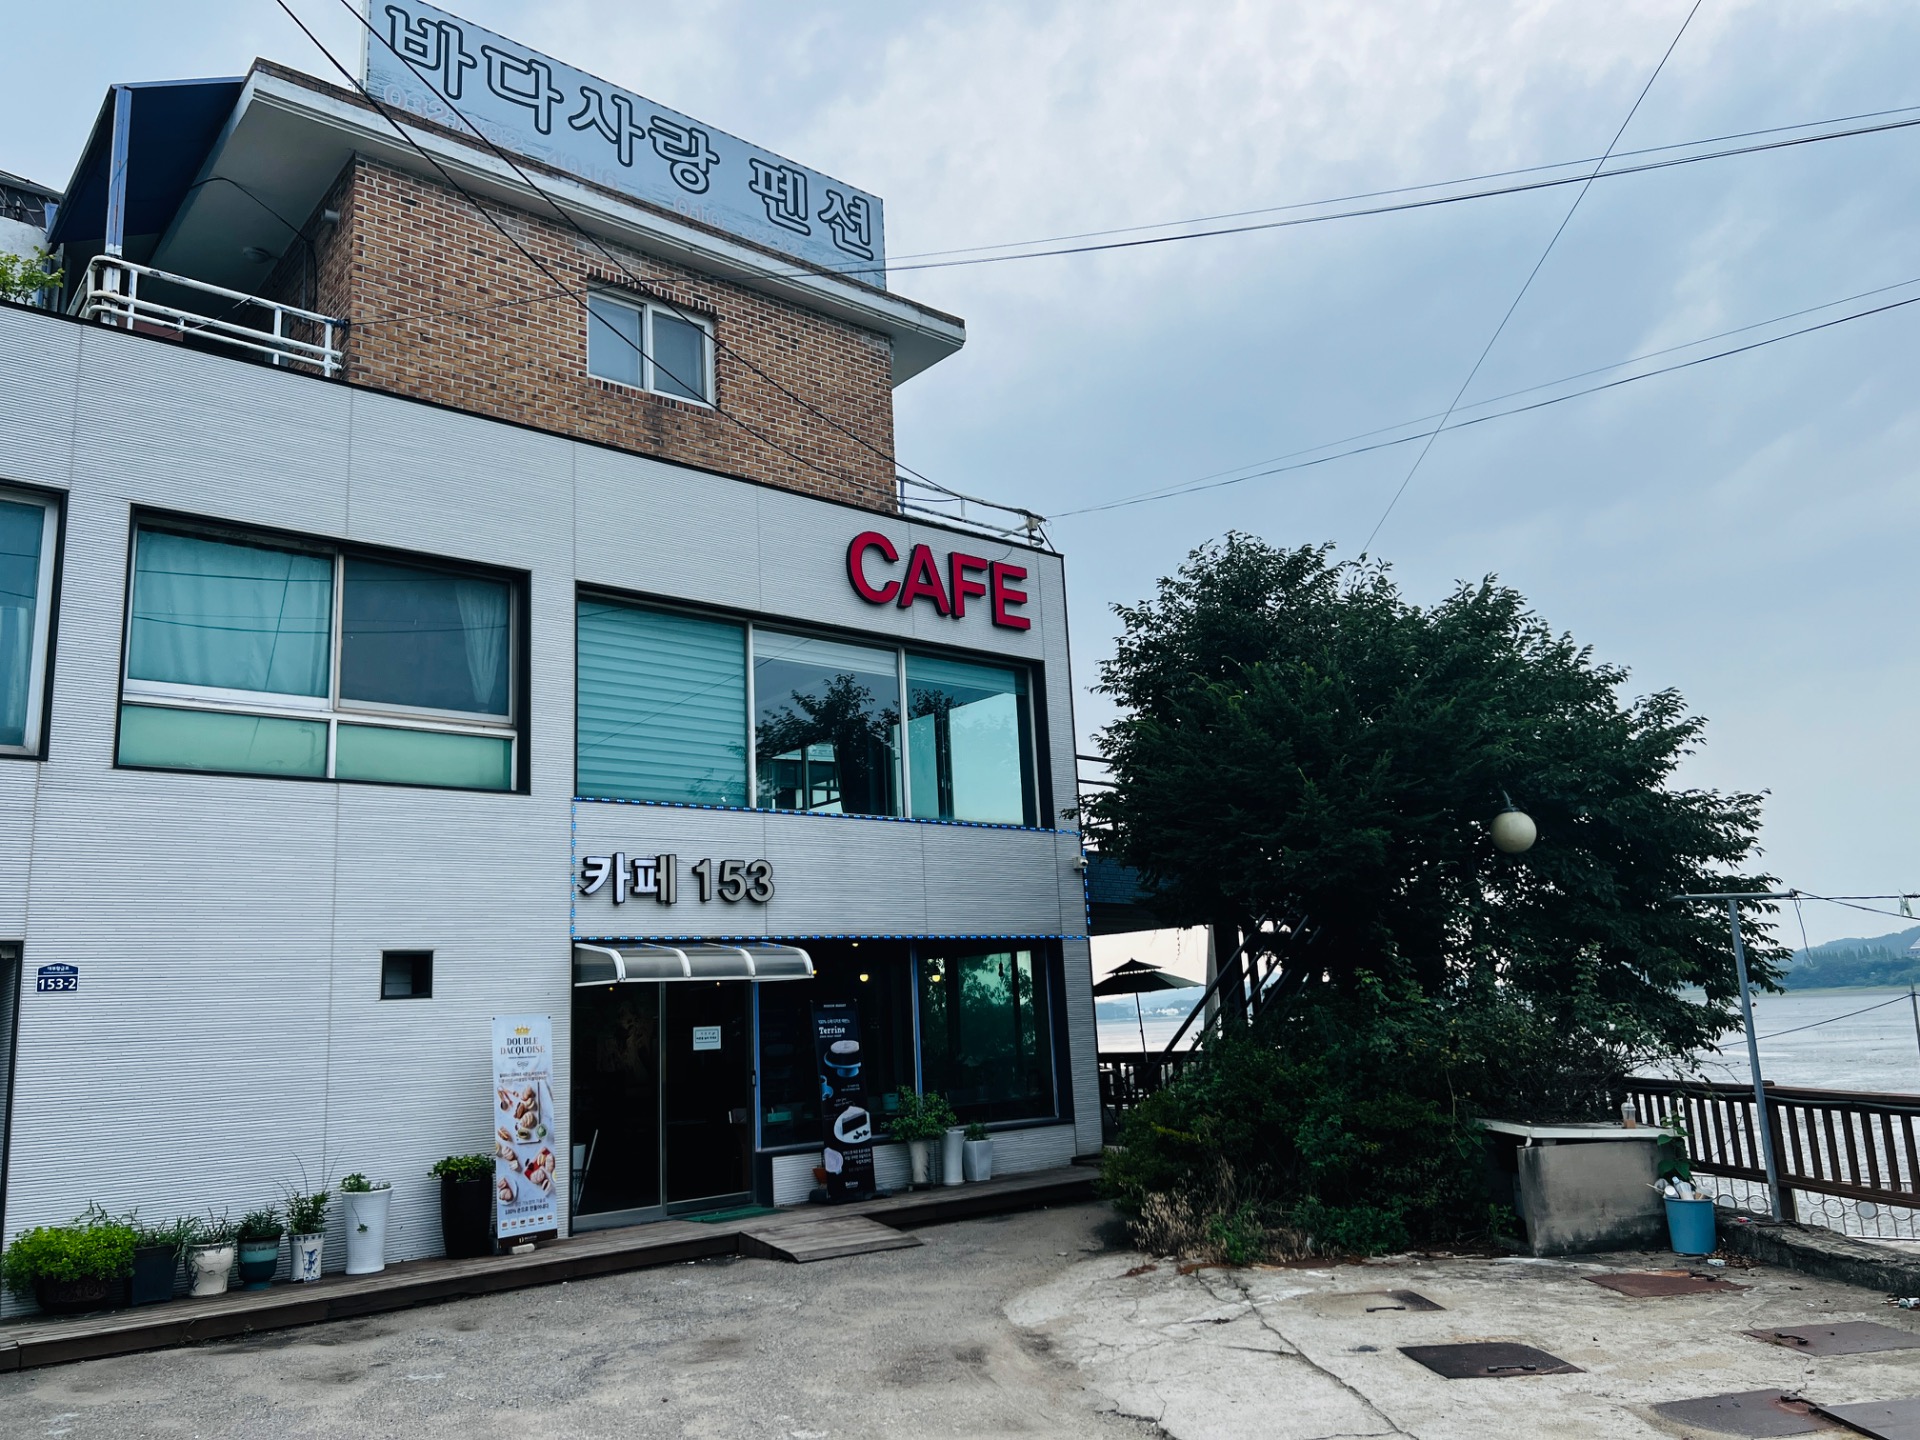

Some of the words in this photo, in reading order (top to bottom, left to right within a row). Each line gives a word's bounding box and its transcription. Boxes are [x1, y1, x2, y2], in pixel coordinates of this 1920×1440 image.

[384, 4, 721, 194] 바다사랑
[749, 157, 875, 262] 펜션
[846, 530, 1032, 631] CAFE
[578, 852, 677, 904] 카페
[691, 857, 775, 903] 153
[39, 977, 76, 990] 153-2
[818, 1025, 846, 1035] Terrine
[506, 1036, 539, 1046] DOUBLE
[500, 1045, 546, 1056] DACQUOISE
